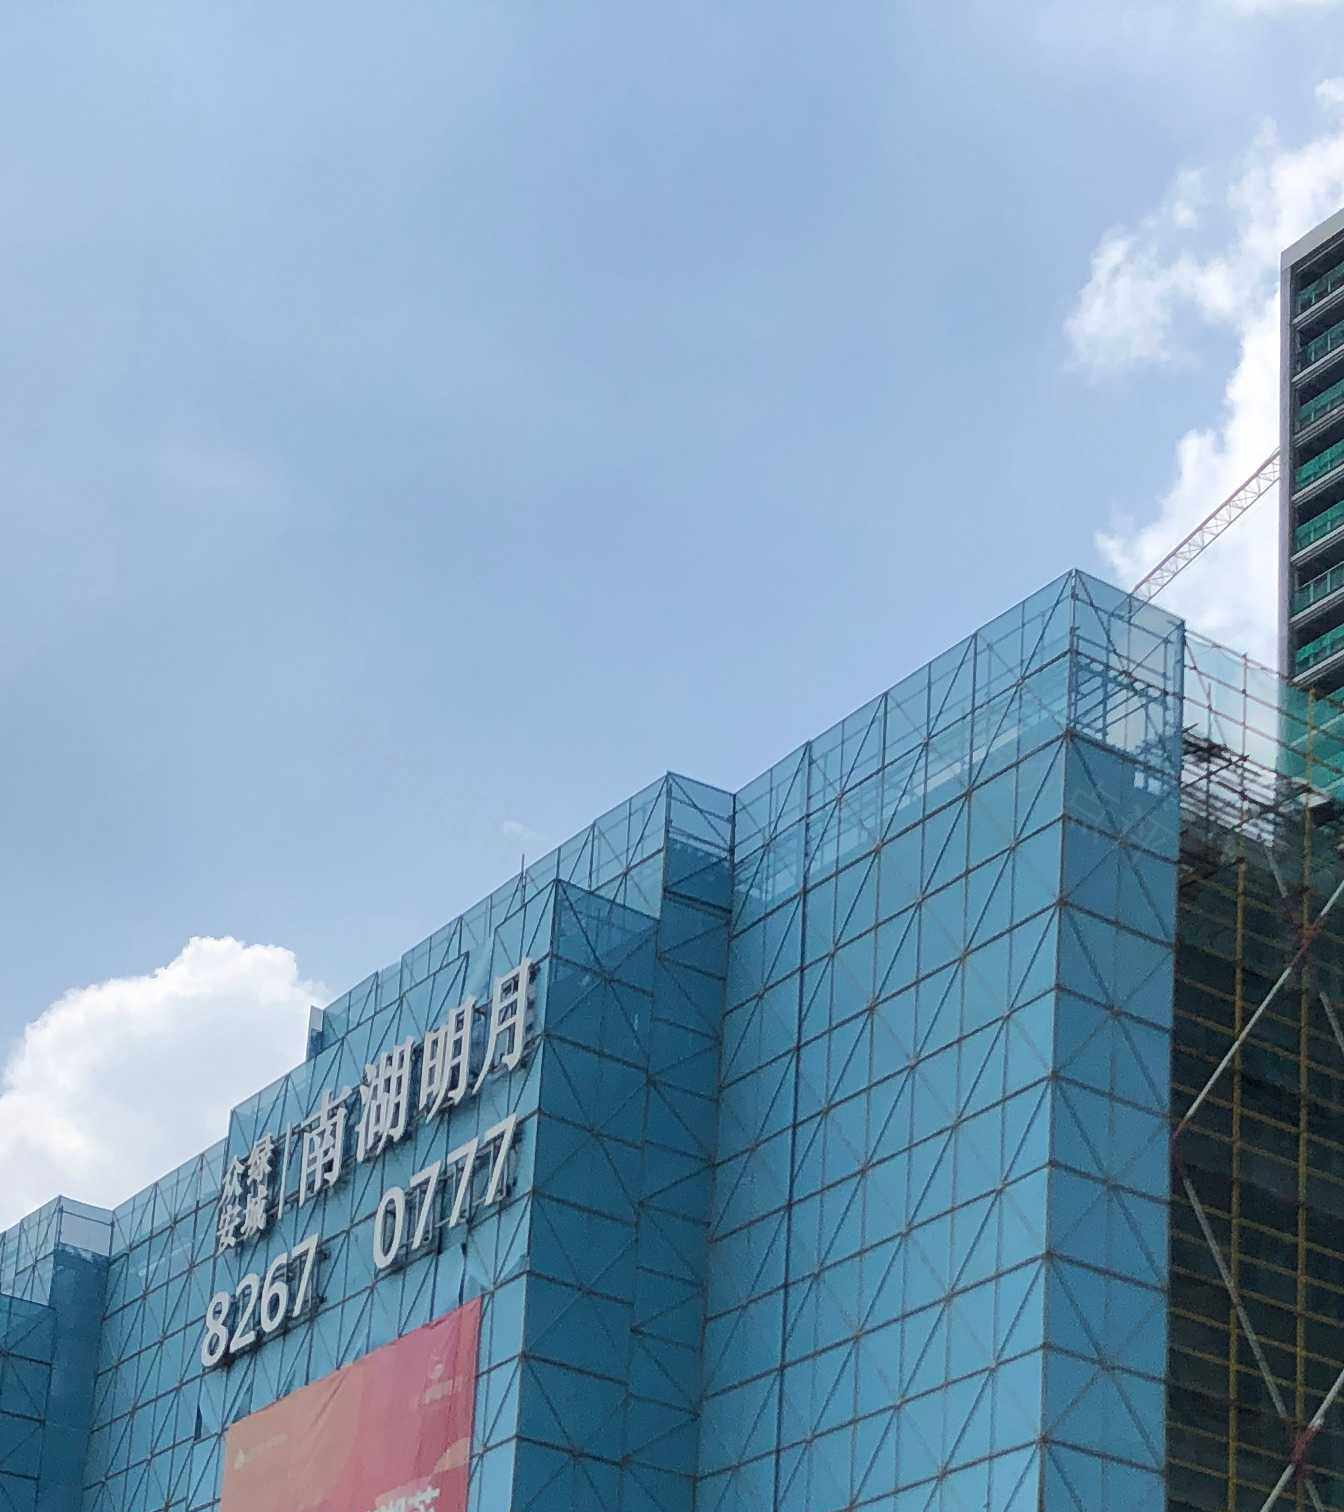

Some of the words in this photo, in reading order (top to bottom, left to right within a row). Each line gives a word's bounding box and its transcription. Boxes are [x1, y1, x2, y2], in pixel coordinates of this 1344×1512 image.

[298, 957, 536, 1209] 南湖明月
[200, 1234, 322, 1368] 8267
[372, 1112, 520, 1270] 0777
